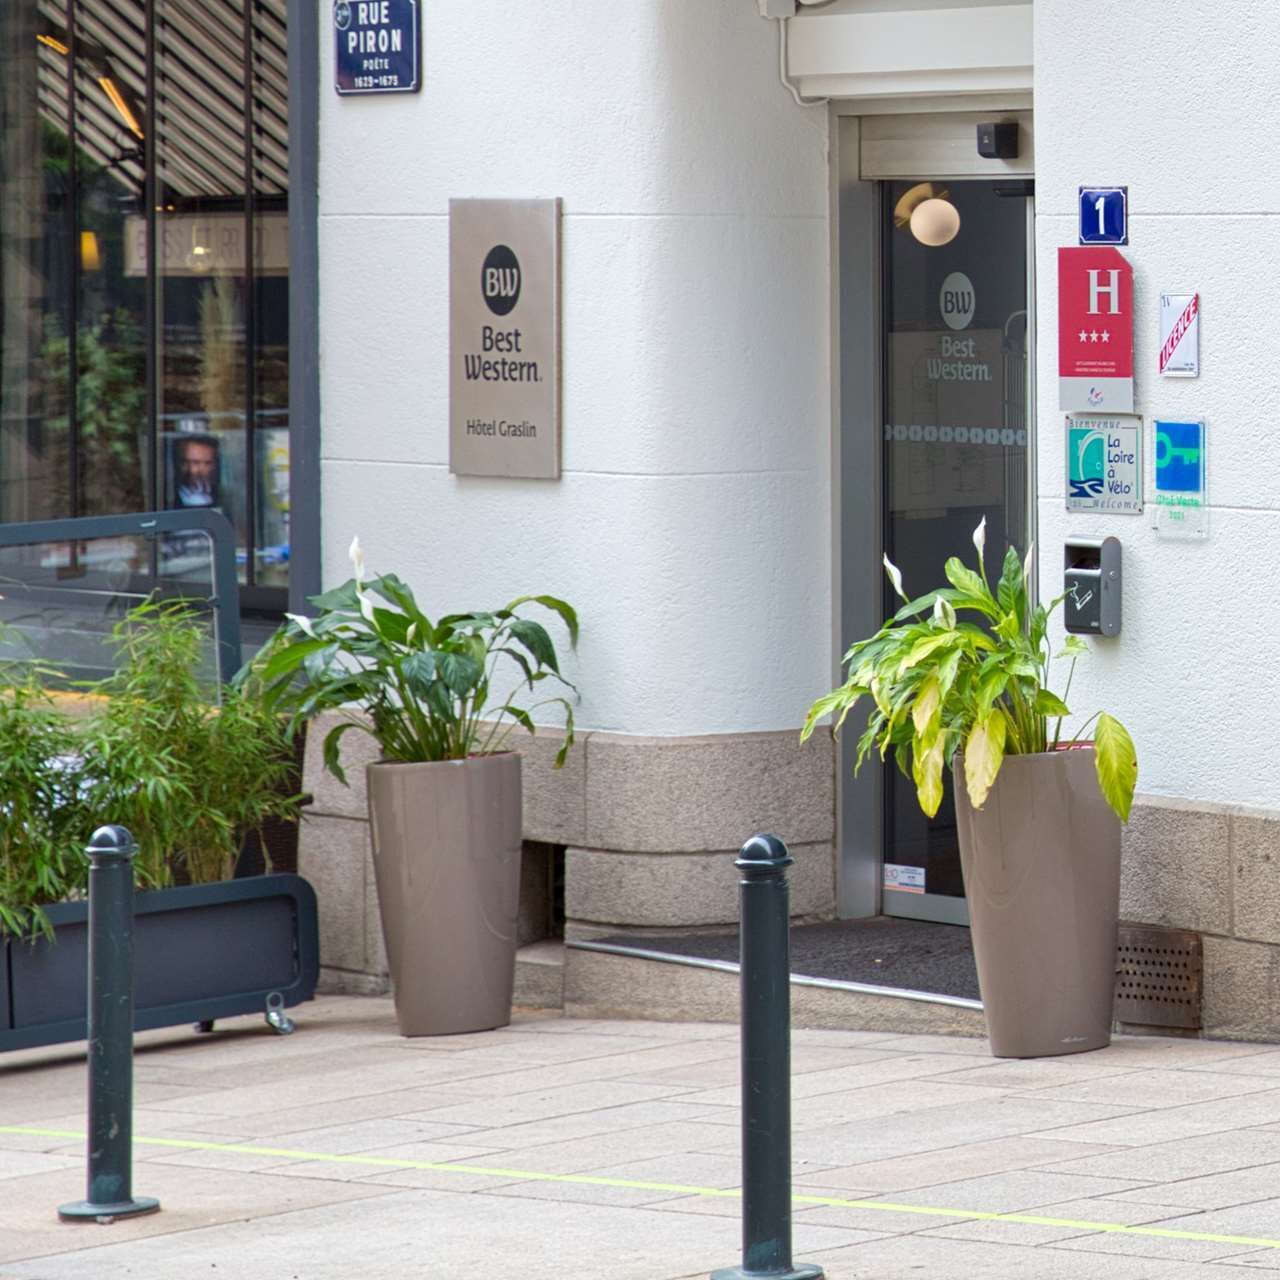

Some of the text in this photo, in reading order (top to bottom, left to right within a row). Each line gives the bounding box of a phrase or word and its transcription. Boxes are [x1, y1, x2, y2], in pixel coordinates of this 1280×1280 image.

[358, 1, 390, 25] RUE
[347, 29, 402, 54] PIRON
[1094, 196, 1106, 235] 1
[485, 267, 519, 297] BW
[1086, 269, 1123, 315] H
[944, 291, 972, 314] BW
[482, 326, 522, 353] Best
[1162, 297, 1197, 370] LICENCE
[942, 335, 976, 358] Best
[466, 419, 537, 438] Hôtel Graslin
[1107, 434, 1121, 448] La
[1107, 450, 1135, 464] Loire
[1107, 465, 1116, 478] à
[1107, 480, 1132, 495] Vélo
